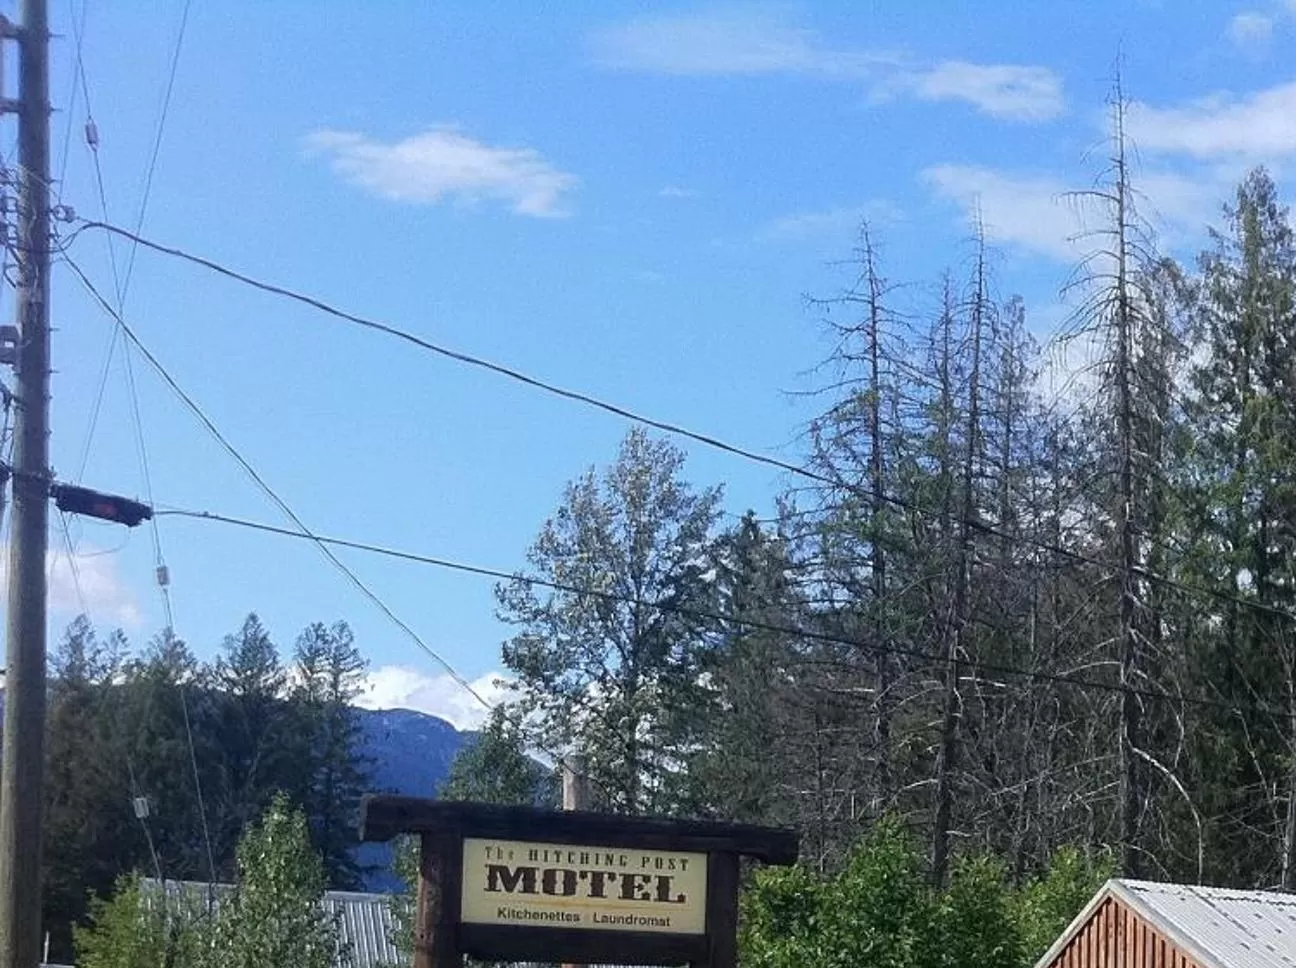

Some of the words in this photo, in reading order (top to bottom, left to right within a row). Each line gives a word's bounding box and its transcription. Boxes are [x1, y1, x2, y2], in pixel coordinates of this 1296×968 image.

[529, 849, 629, 868] HITCHING
[641, 856, 690, 871] POST
[484, 863, 687, 904] MOTEL
[497, 907, 581, 923] Kitchenettes
[593, 914, 671, 928] Laundromat
